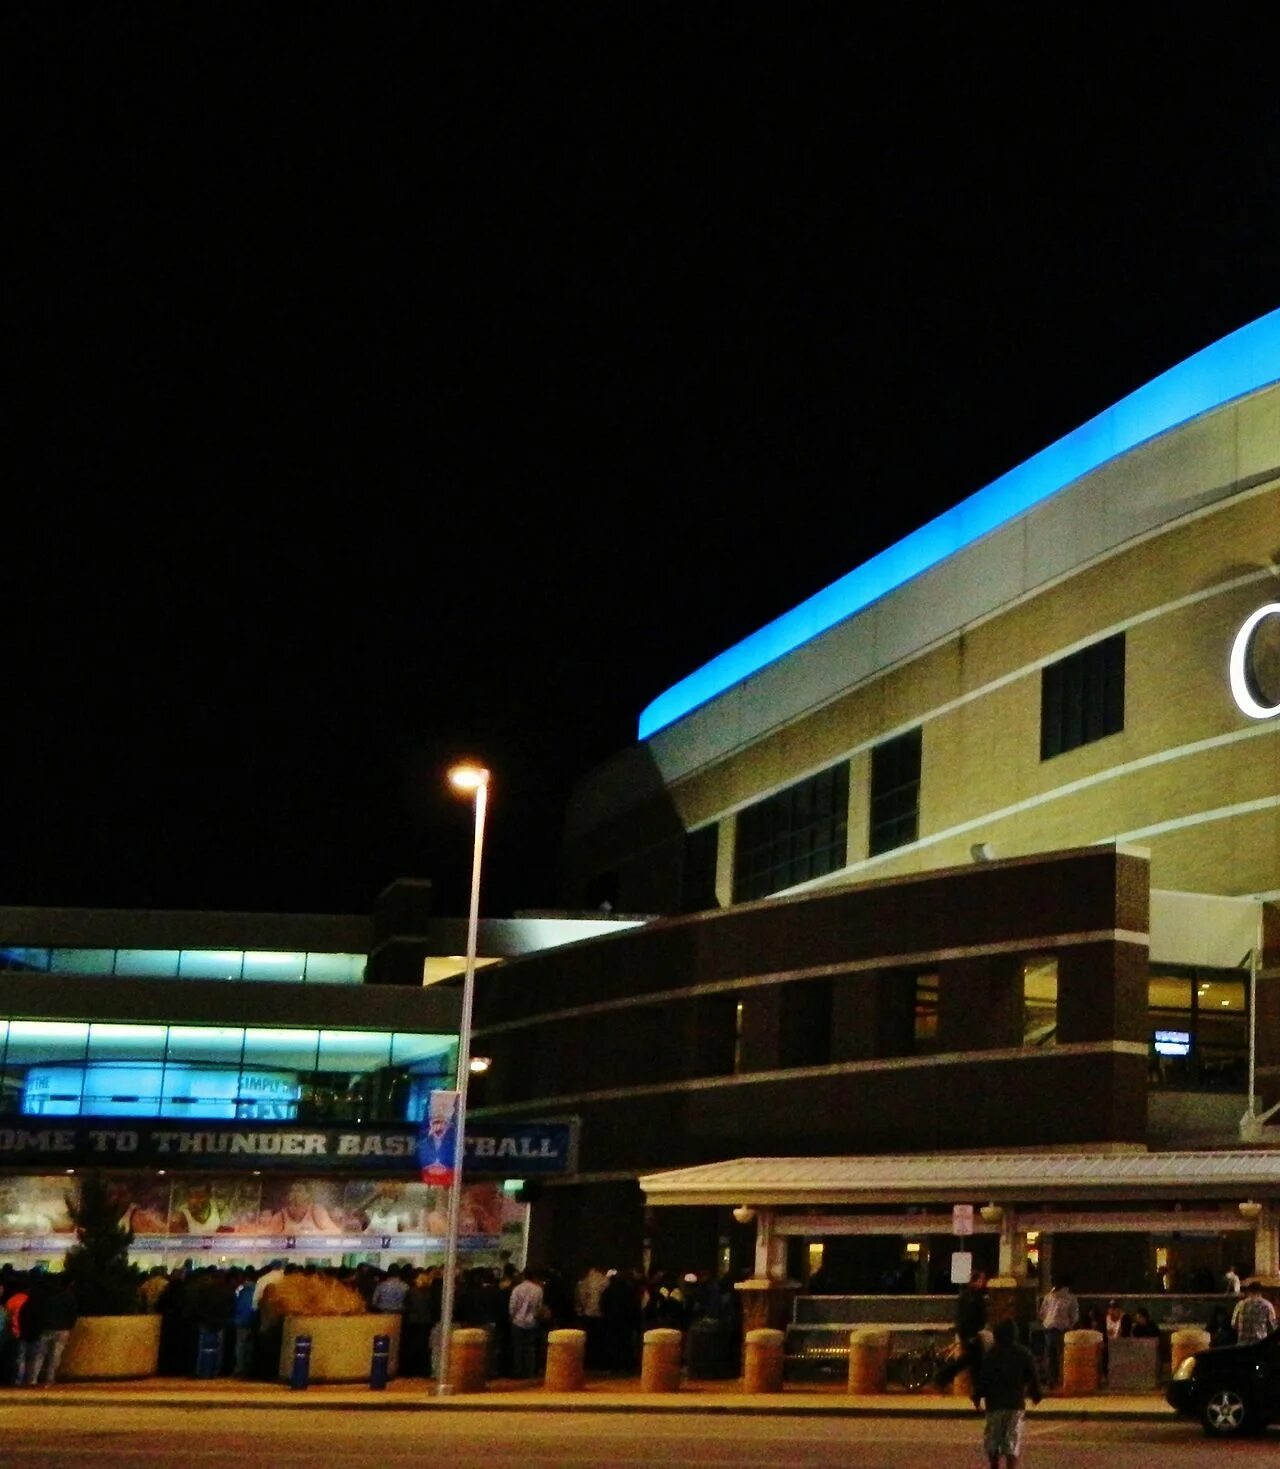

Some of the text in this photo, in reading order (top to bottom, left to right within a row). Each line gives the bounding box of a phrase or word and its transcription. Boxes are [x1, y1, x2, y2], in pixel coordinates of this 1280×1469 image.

[89, 1130, 139, 1151] TO
[151, 1132, 326, 1155] THUNDER
[336, 1134, 558, 1158] BASBALL
